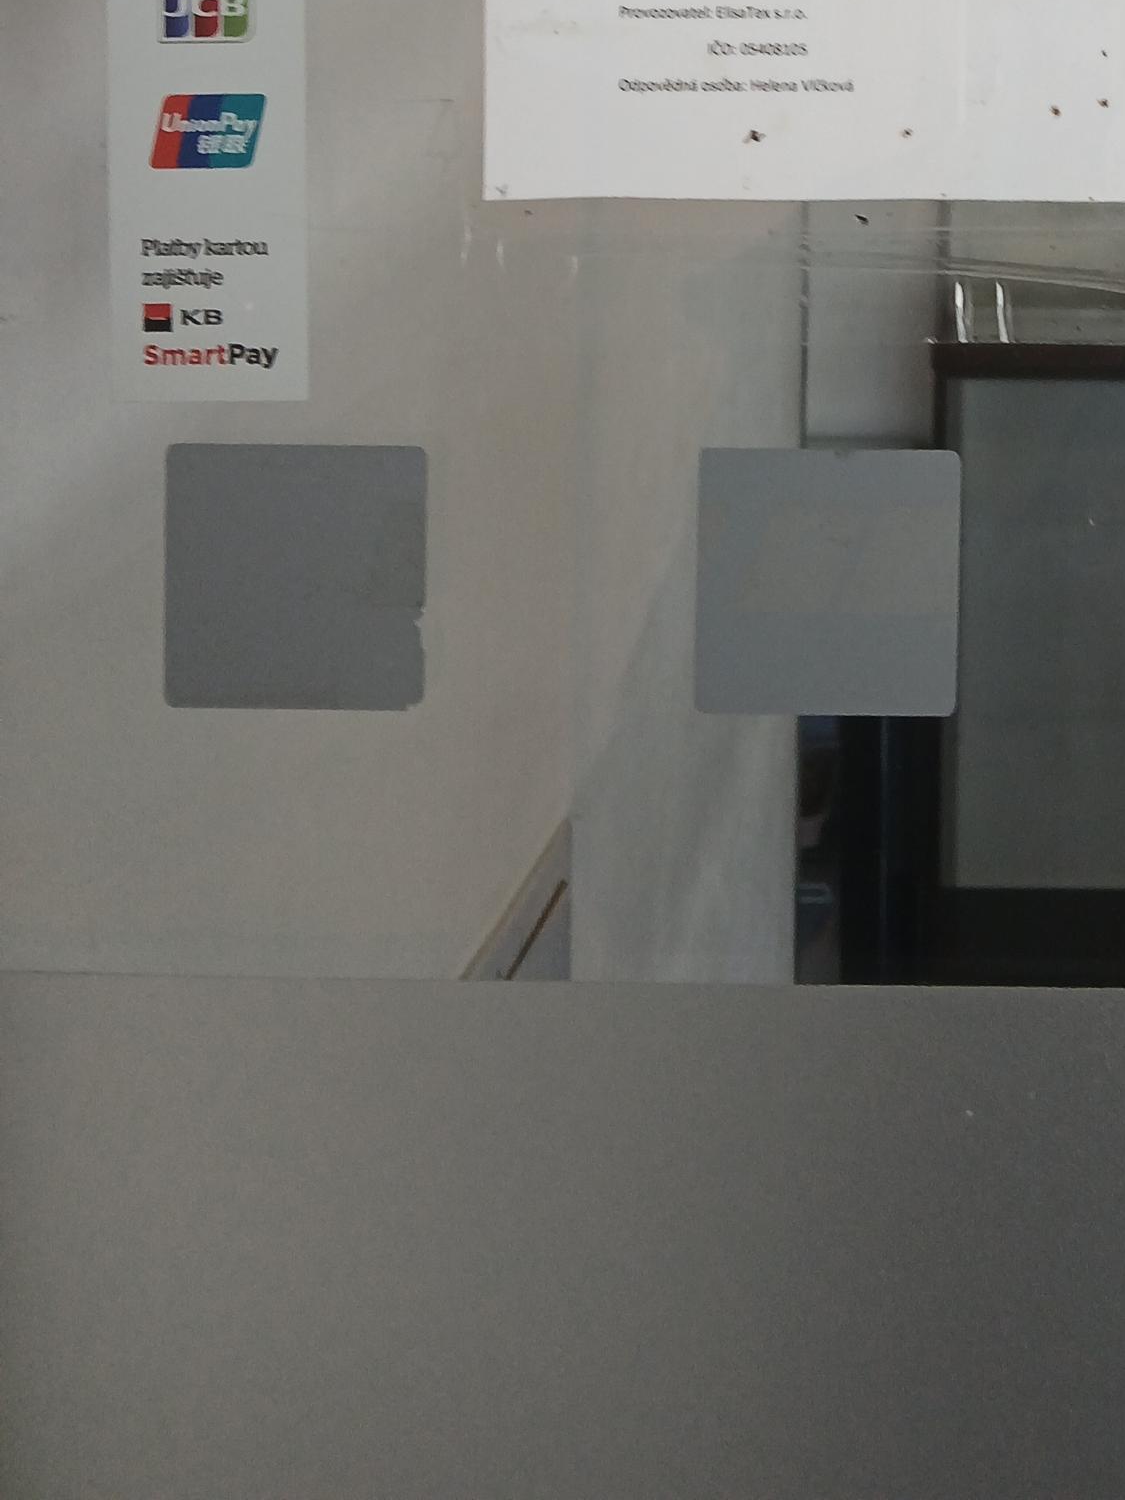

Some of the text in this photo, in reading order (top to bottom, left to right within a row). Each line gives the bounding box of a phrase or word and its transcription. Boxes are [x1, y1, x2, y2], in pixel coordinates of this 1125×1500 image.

[700, 77, 748, 93] osoba:
[750, 78, 798, 93] Helena
[203, 238, 269, 256] kartou
[180, 309, 224, 326] KB
[144, 343, 279, 369] SmartPay
